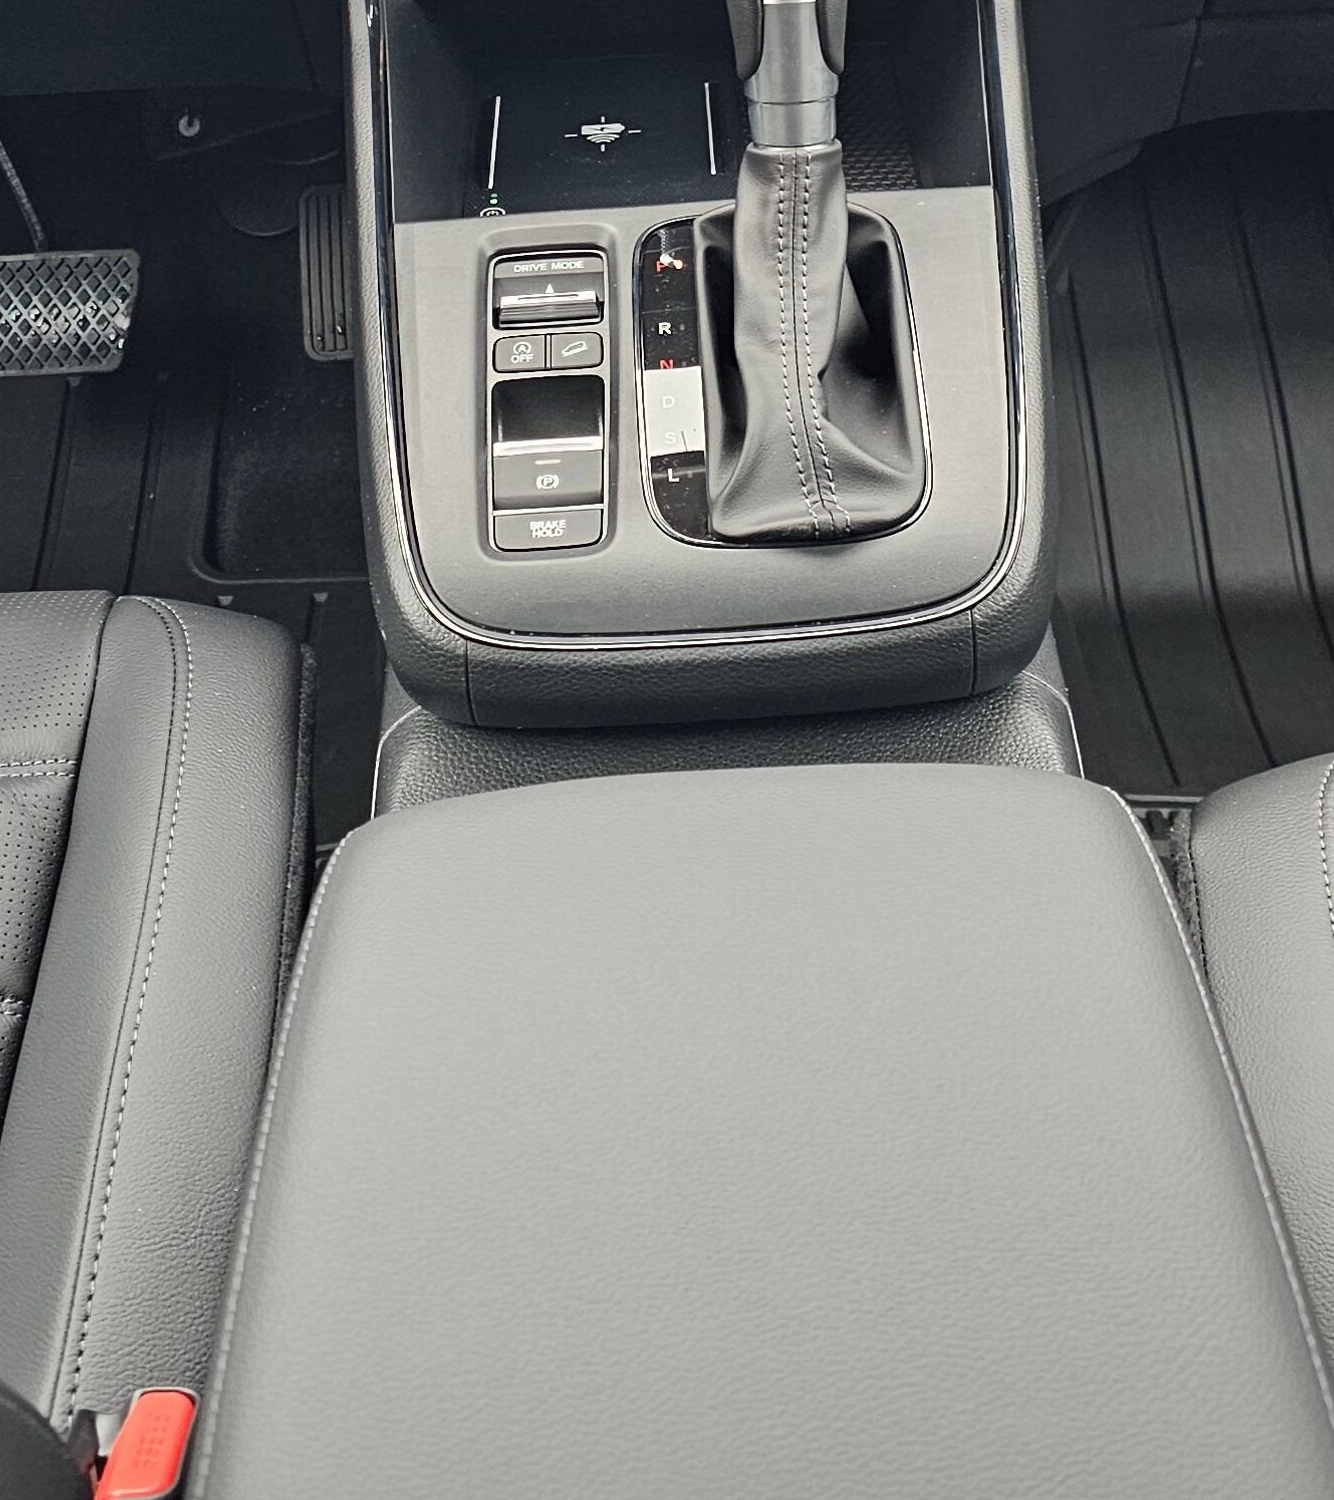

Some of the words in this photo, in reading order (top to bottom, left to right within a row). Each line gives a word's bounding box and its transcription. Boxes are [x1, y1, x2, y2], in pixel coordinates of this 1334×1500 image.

[513, 263, 548, 274] DRIVE
[551, 260, 584, 271] MODE
[658, 322, 672, 335] R
[510, 353, 534, 364] OFF
[659, 359, 673, 370] N
[662, 395, 676, 409] D
[665, 431, 677, 444] S
[667, 468, 680, 483] L
[529, 519, 566, 531] BRAKE
[531, 528, 564, 539] HOLD
